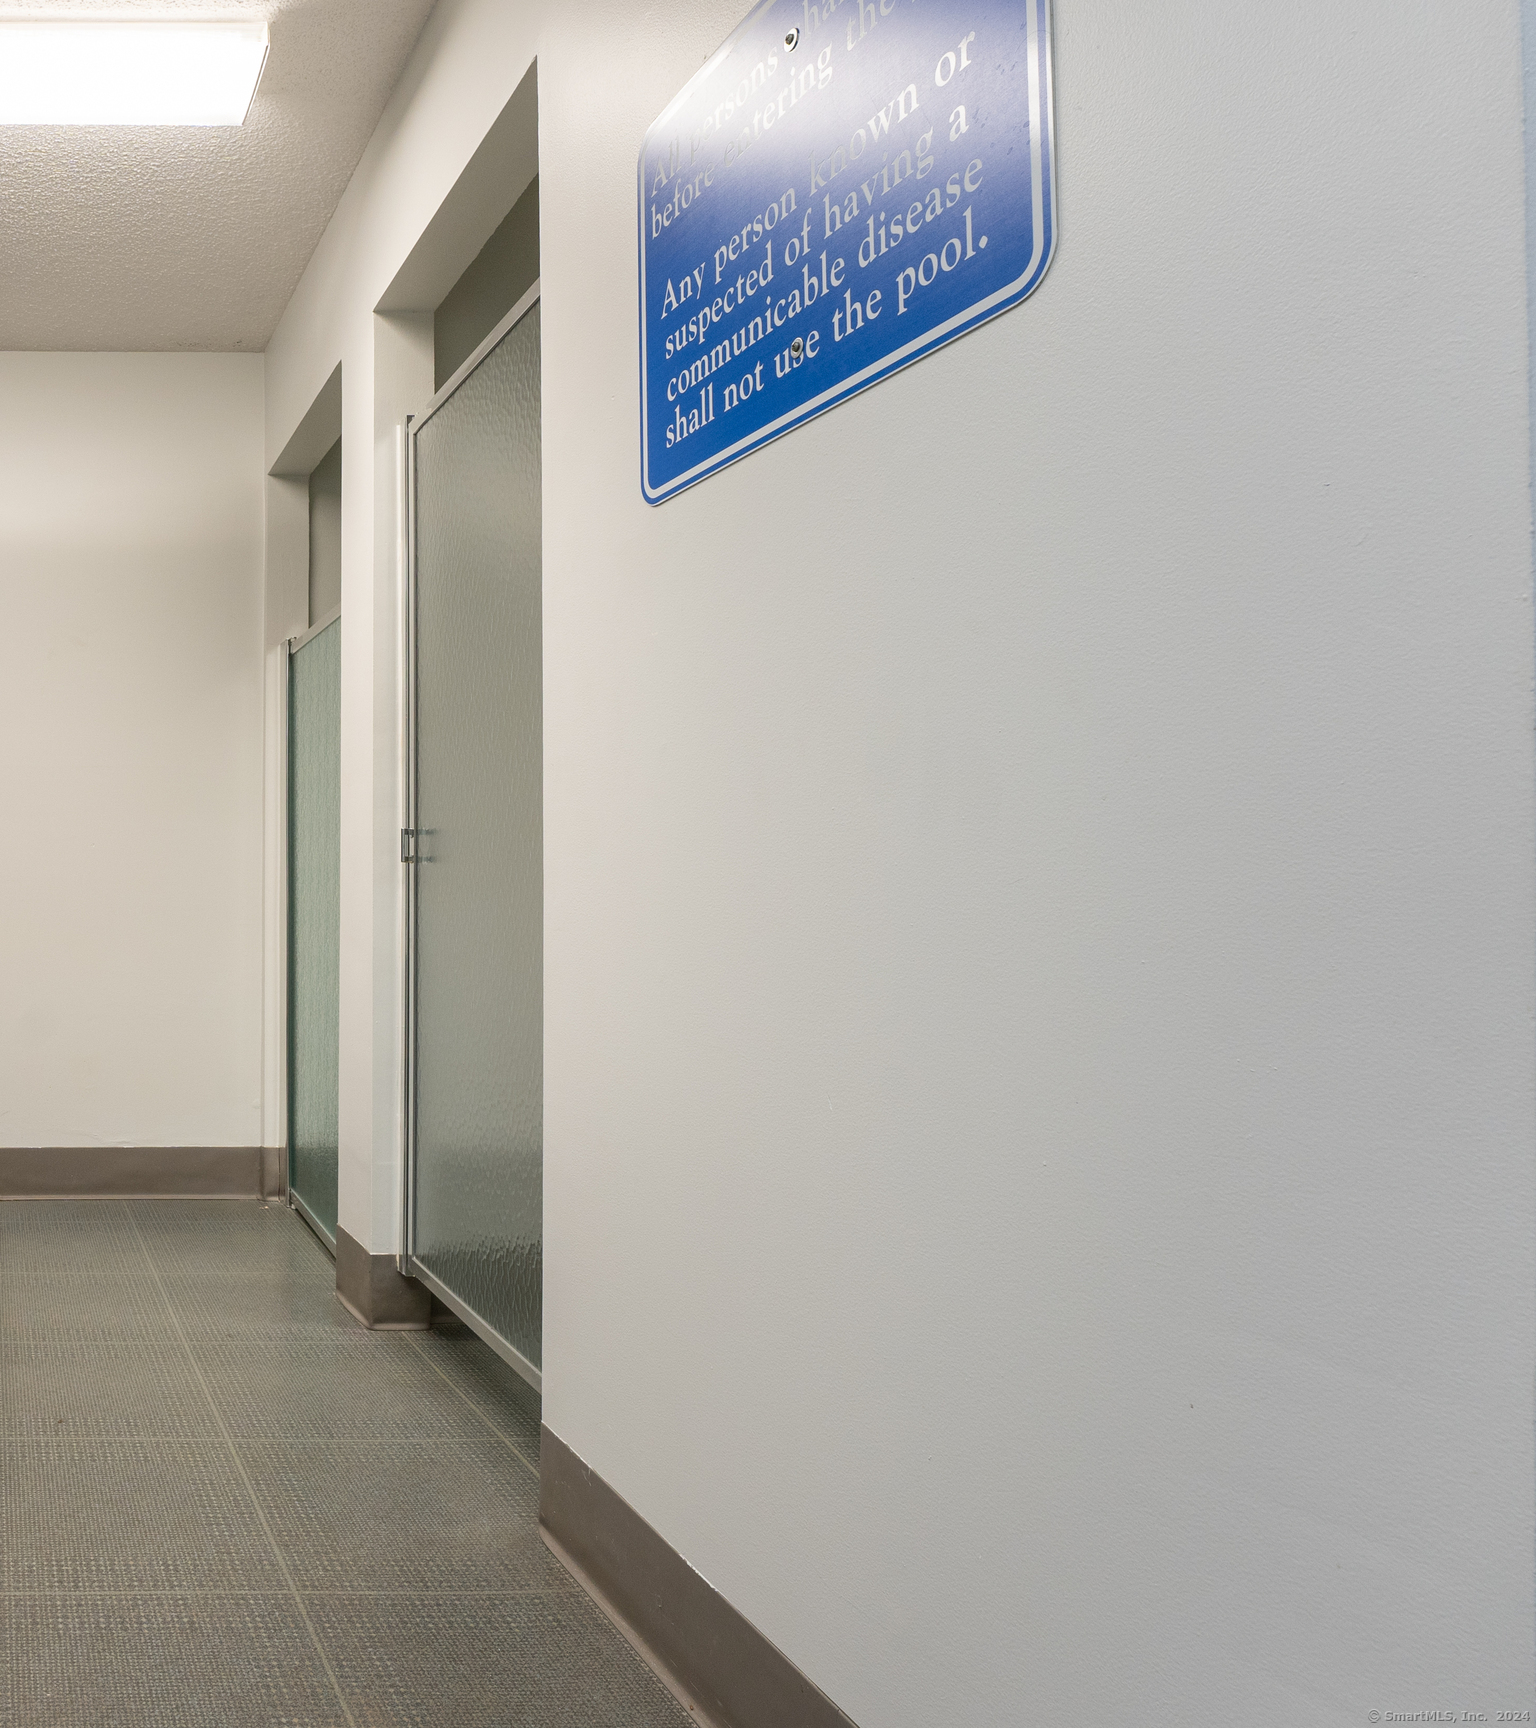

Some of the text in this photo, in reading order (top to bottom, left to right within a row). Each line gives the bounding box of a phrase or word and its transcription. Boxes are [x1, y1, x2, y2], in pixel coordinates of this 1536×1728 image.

[651, 47, 778, 198] All persons
[651, 160, 714, 240] before
[724, 41, 833, 168] entering
[661, 30, 975, 320] Any person known or
[665, 104, 969, 360] suspected of having a
[666, 382, 715, 448] shall
[723, 361, 764, 412] not
[832, 288, 882, 342] the
[895, 205, 988, 316] pool.
[667, 158, 983, 402] communicable disease
